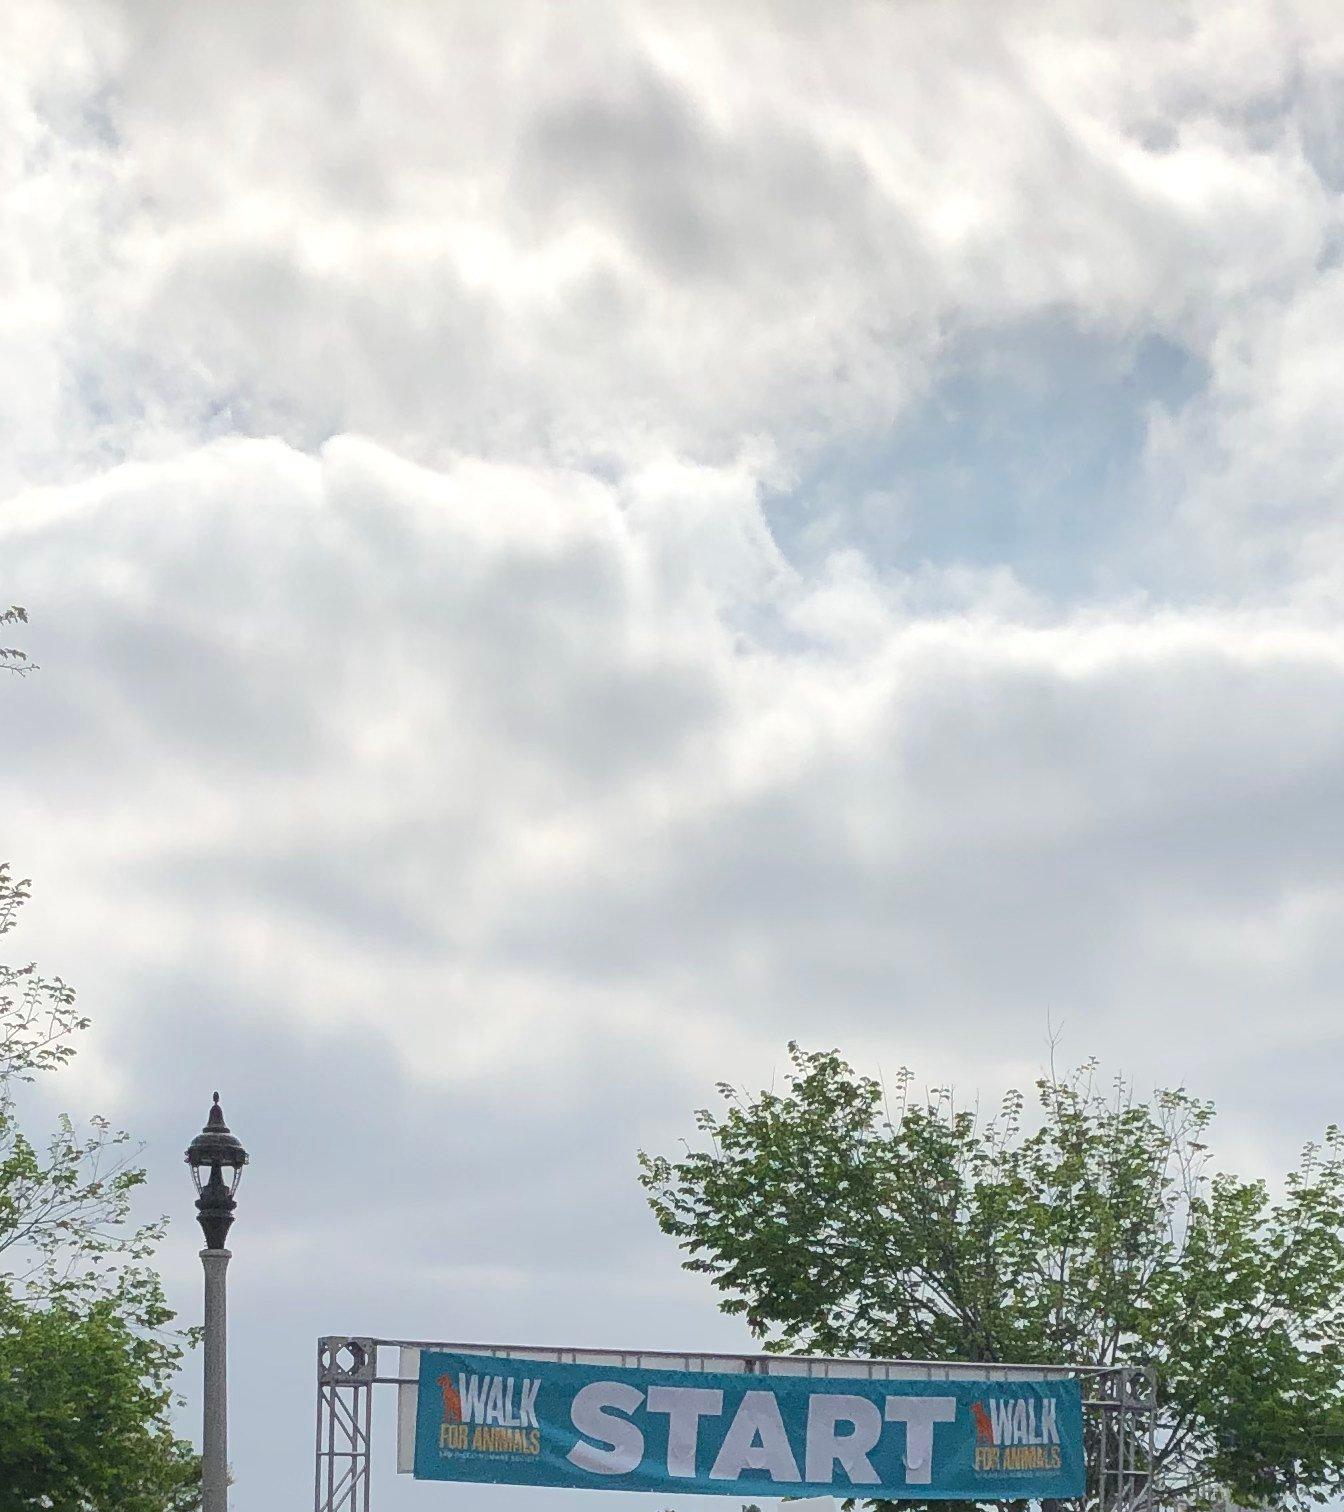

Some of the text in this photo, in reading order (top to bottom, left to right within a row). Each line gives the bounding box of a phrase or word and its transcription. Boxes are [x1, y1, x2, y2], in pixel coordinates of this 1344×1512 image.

[459, 1373, 542, 1428] WALK
[989, 1398, 1060, 1445] WALK
[439, 1423, 541, 1455] FOR ANIMALS
[565, 1380, 956, 1485] START
[1003, 1445, 1061, 1470] ANIMALS
